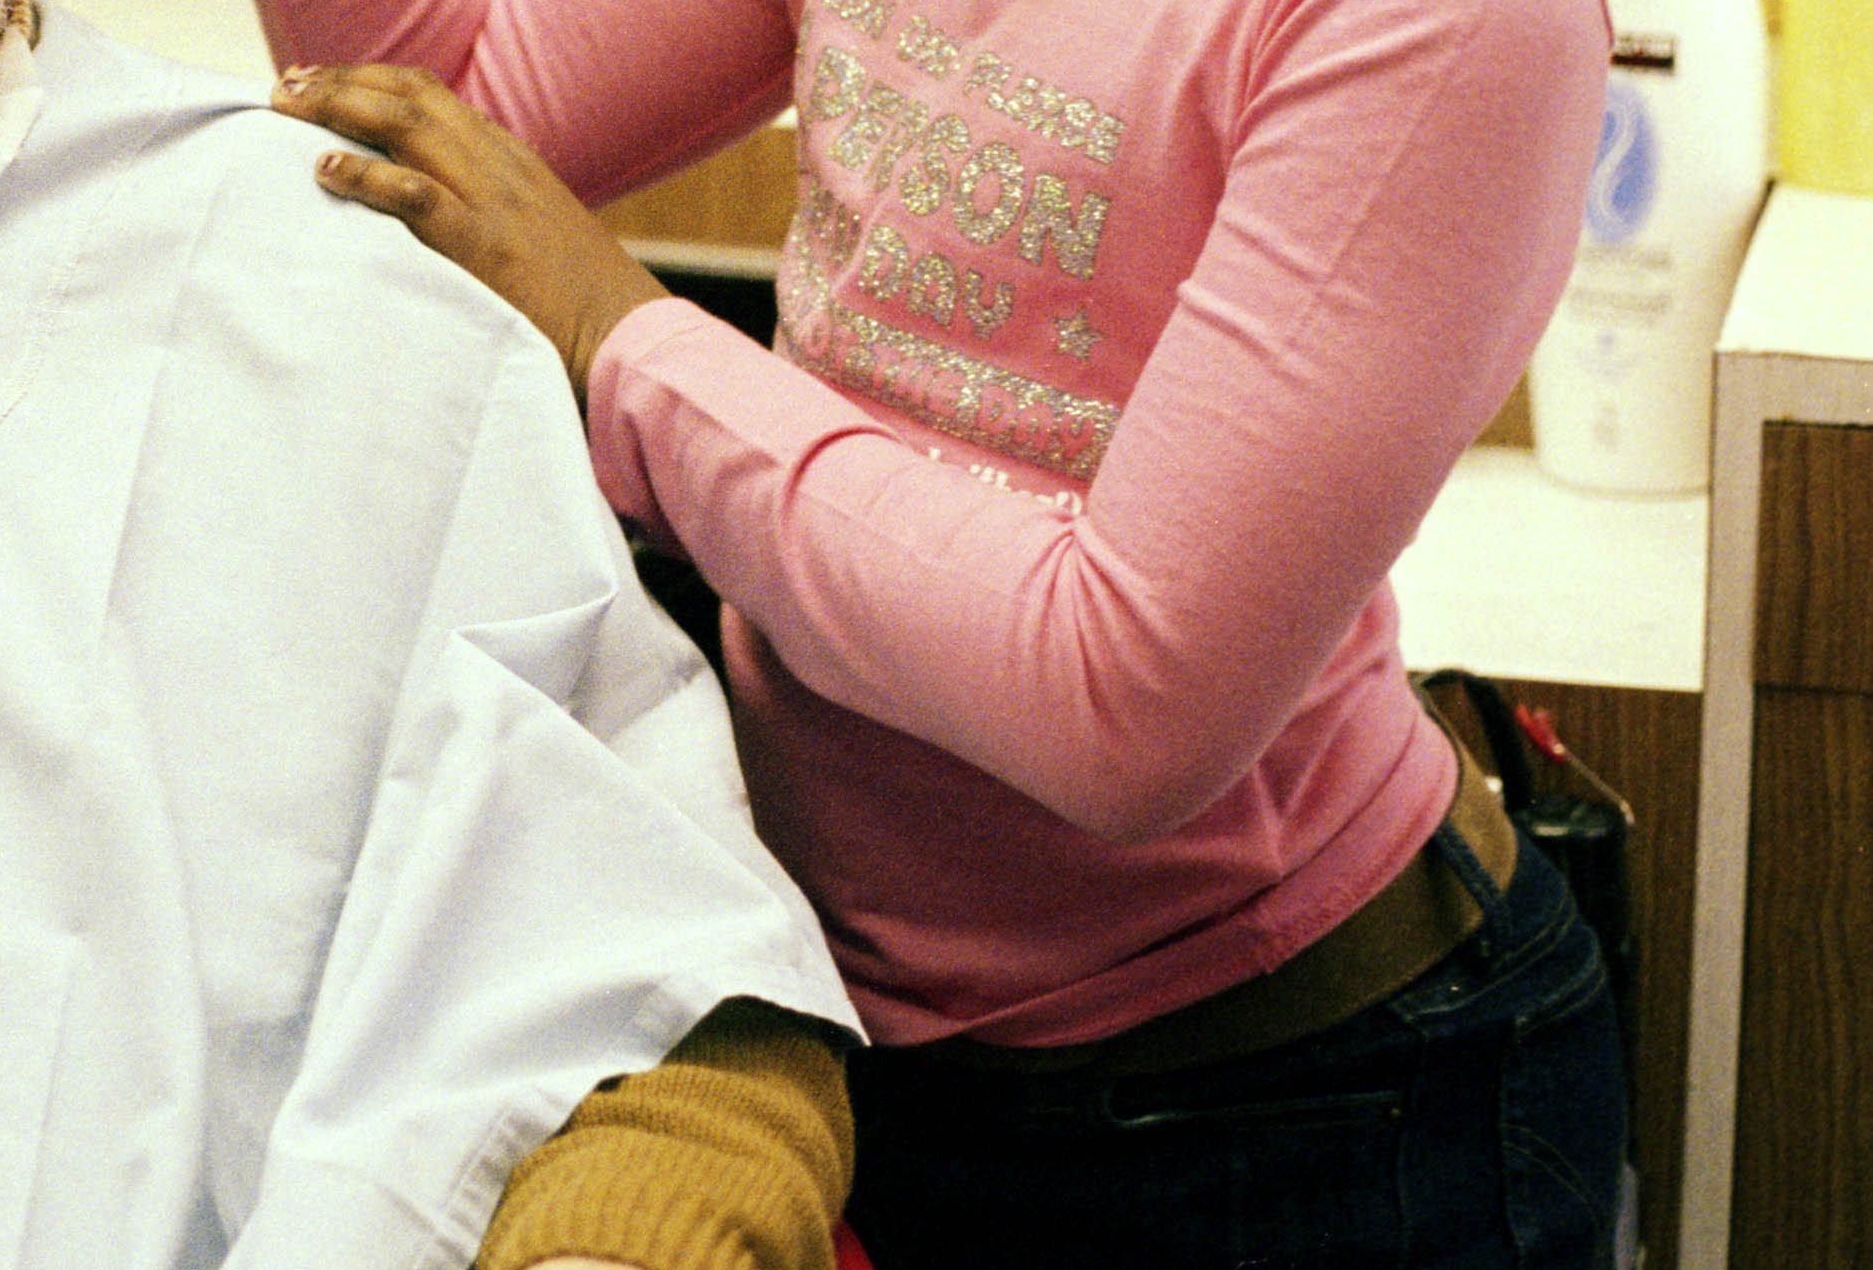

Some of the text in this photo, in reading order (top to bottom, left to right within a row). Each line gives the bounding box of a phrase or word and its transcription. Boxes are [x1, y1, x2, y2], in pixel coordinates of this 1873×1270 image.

[804, 46, 1112, 282] PERSON
[963, 51, 1126, 165] PLEASE
[859, 225, 1017, 341] DAY
[871, 342, 962, 420] THE
[975, 383, 1098, 459] DAY
